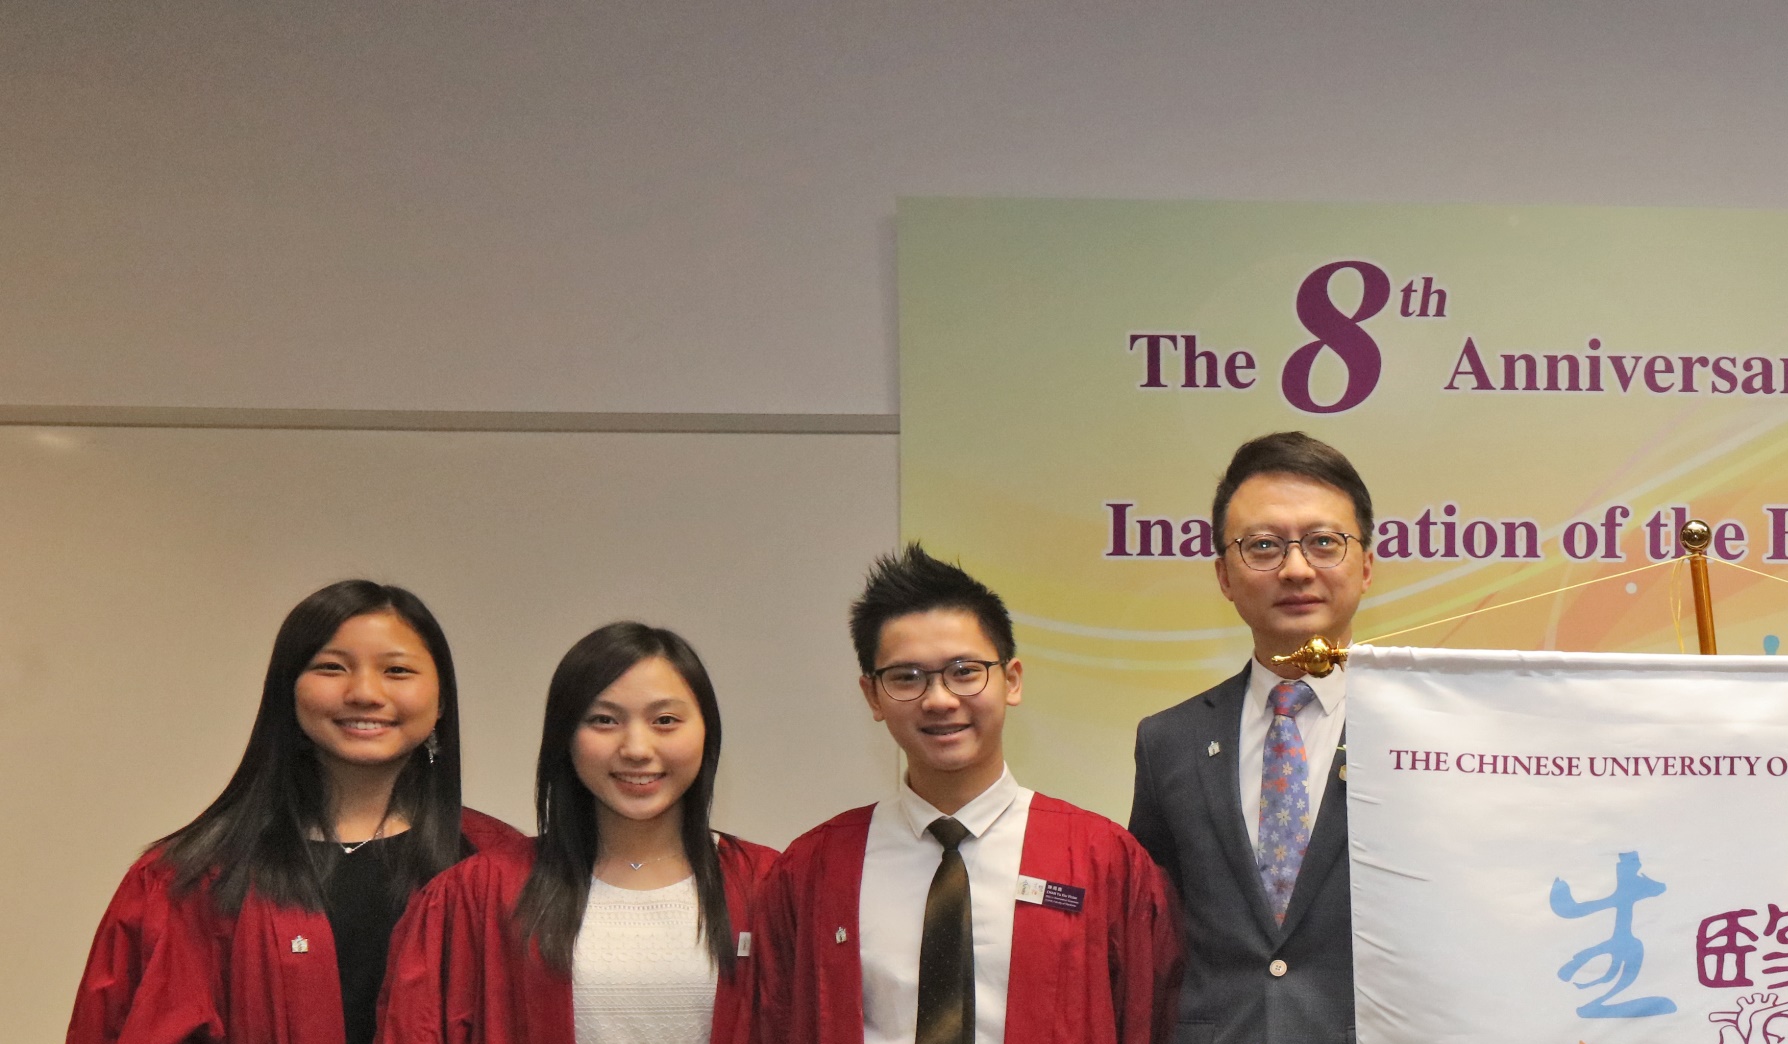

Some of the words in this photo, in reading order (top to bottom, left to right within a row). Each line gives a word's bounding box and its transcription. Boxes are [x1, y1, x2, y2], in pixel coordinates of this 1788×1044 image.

[1129, 334, 1257, 389] The
[1106, 502, 1541, 559] Inaation
[1562, 504, 1630, 559] of
[1389, 749, 1450, 772] THE
[1456, 752, 1582, 777] CHINESE
[1588, 755, 1763, 778] UNIVERSITY
